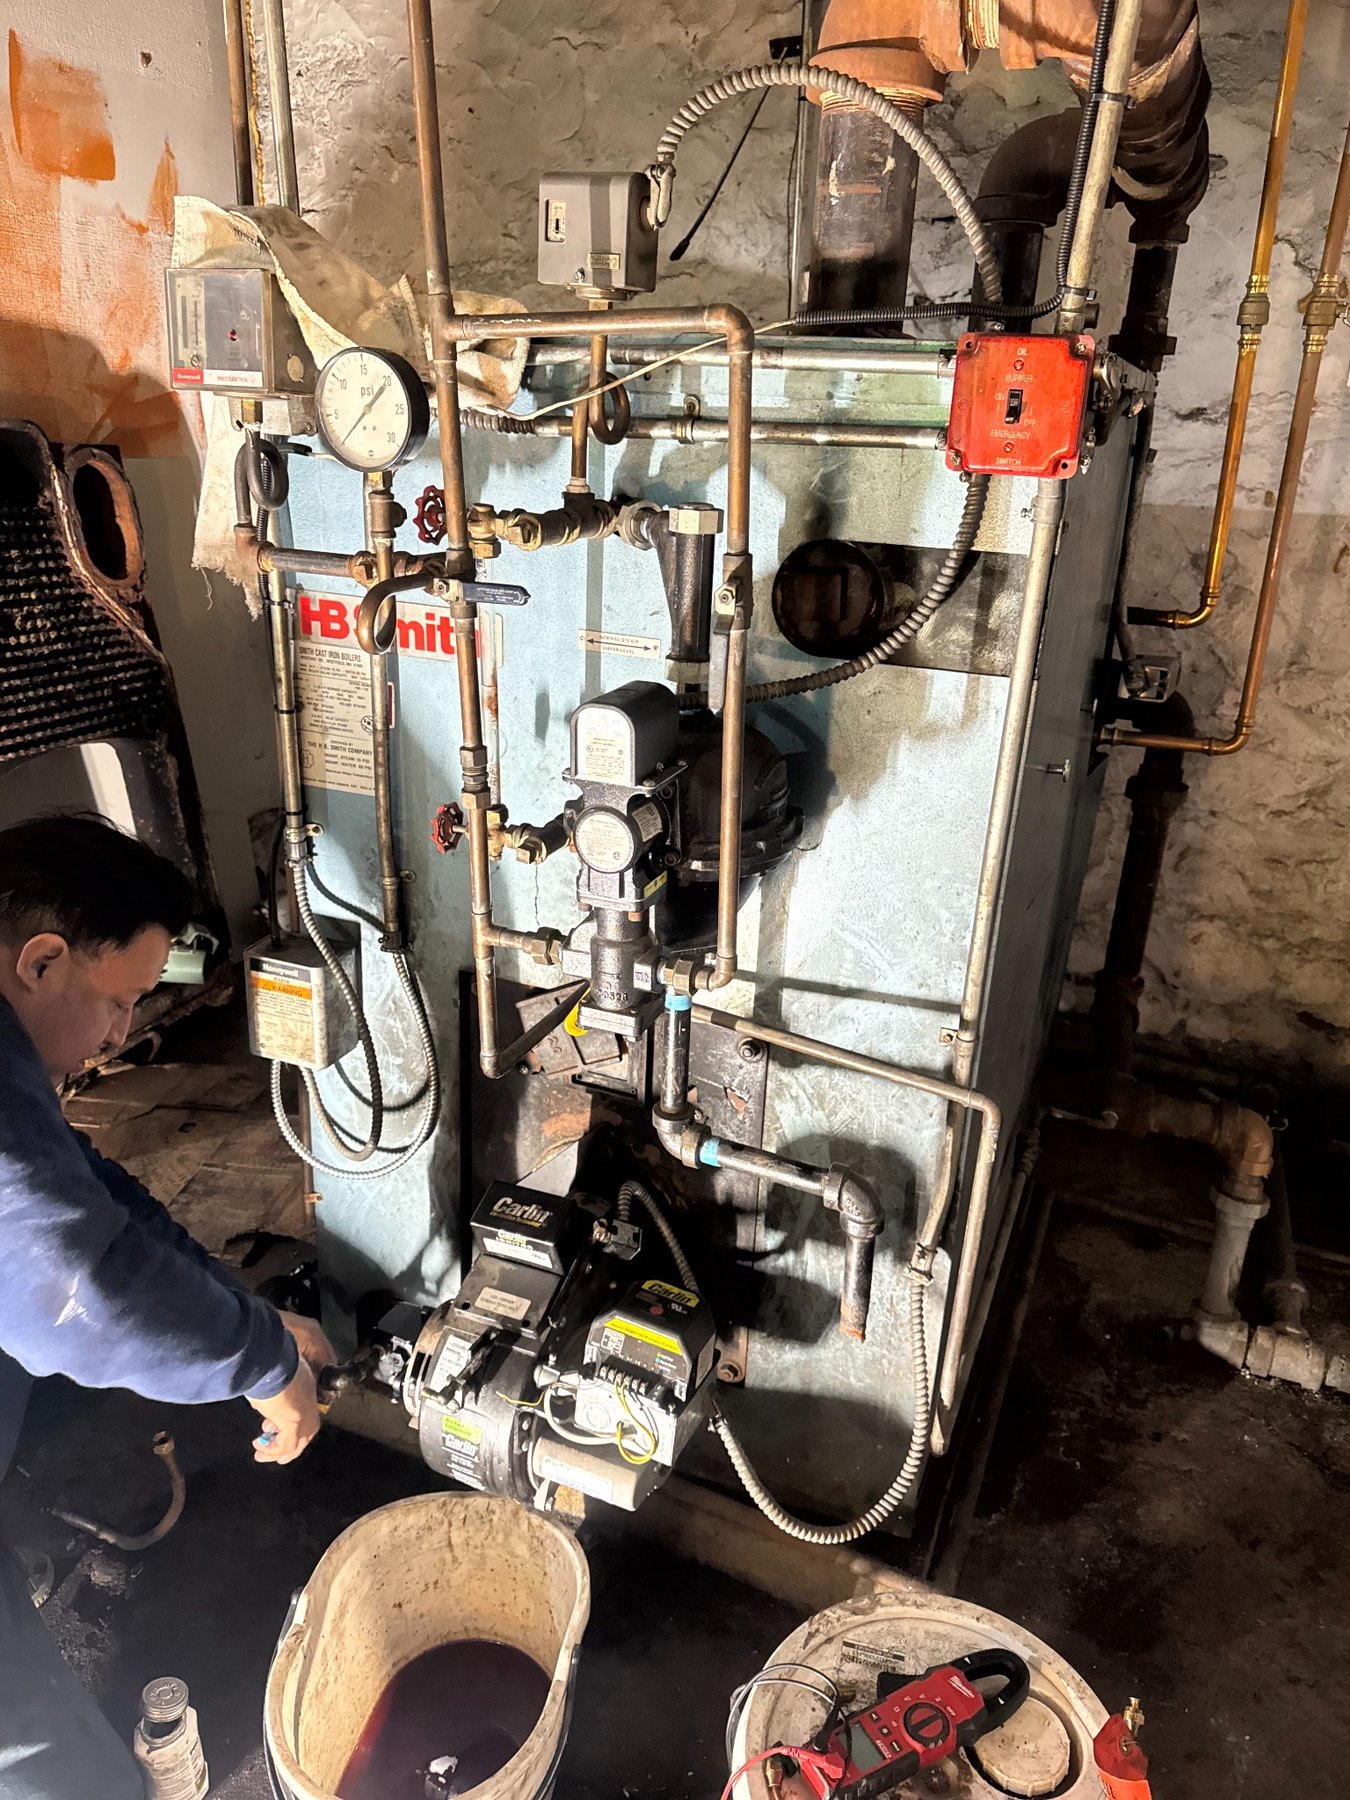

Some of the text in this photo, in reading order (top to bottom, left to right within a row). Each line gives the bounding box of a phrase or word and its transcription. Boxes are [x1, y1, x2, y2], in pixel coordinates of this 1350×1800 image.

[1017, 348, 1028, 356] OIL
[360, 364, 368, 376] 15
[383, 376, 392, 387] 20
[1005, 373, 1033, 383] BURNER
[340, 379, 347, 390] 10
[360, 386, 374, 398] psi
[994, 392, 1005, 401] ON
[334, 410, 339, 420] 5
[395, 404, 405, 415] 25
[387, 432, 396, 443] 30
[990, 430, 1030, 440] EMERGENCY
[995, 457, 1022, 466] SWITCH
[300, 595, 480, 657] HB mit
[315, 648, 327, 658] CAST
[328, 651, 340, 660] IRON
[341, 652, 362, 663] BOILERS
[348, 748, 372, 756] COMPANY
[262, 963, 298, 977] Honeywell
[272, 985, 303, 997] WARNING
[492, 1197, 550, 1222] Carlin
[648, 1284, 693, 1304] Carlin
[446, 1433, 478, 1456] Carlin
